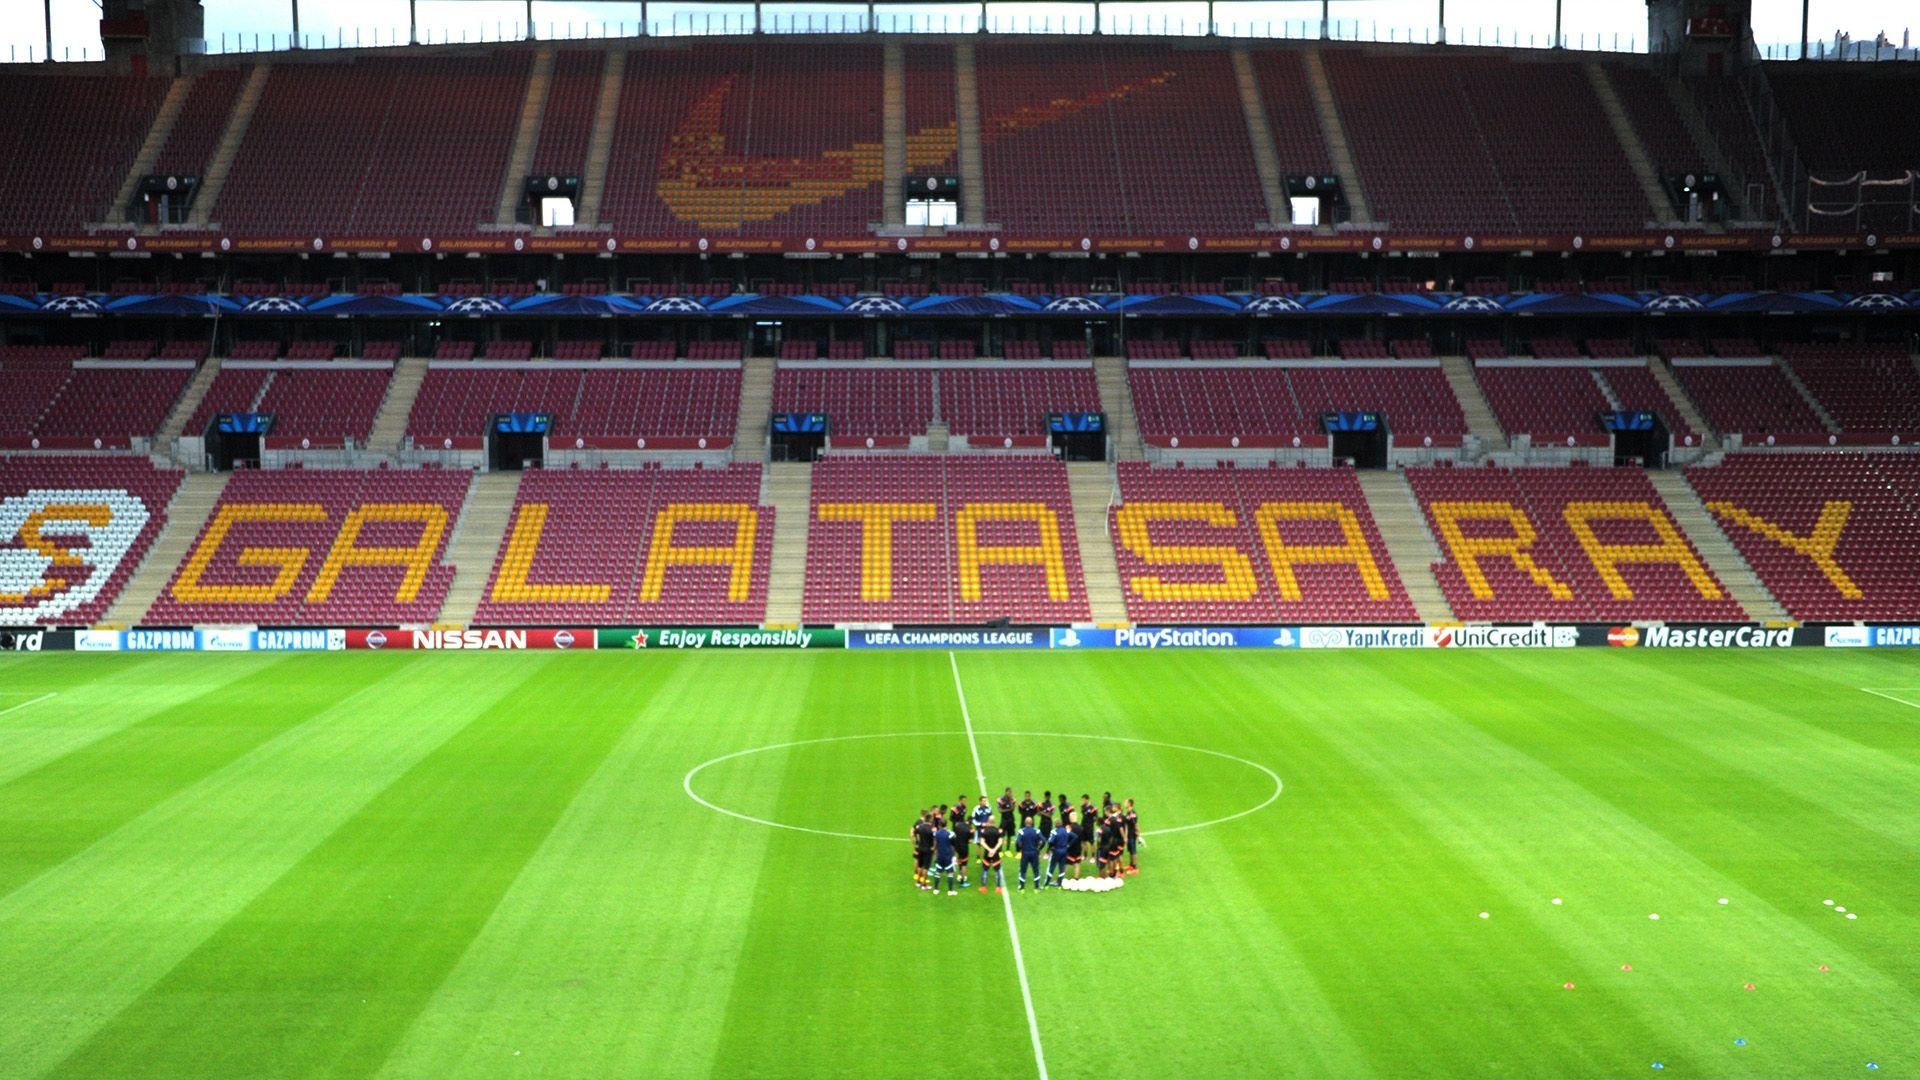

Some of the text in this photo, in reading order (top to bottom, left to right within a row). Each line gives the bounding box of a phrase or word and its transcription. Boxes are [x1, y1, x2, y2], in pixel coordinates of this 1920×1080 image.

[170, 500, 1865, 605] GALATASARAY
[127, 631, 195, 650] GAZPROM
[258, 631, 326, 650] GAZPROM
[412, 630, 527, 650] NISSAN
[659, 630, 812, 648] Enjoy Responsibly
[865, 632, 1033, 647] UEFA CHAMPIONS LEAGUE
[1454, 628, 1548, 648] UniCredit
[1644, 627, 1794, 648] MasterCard
